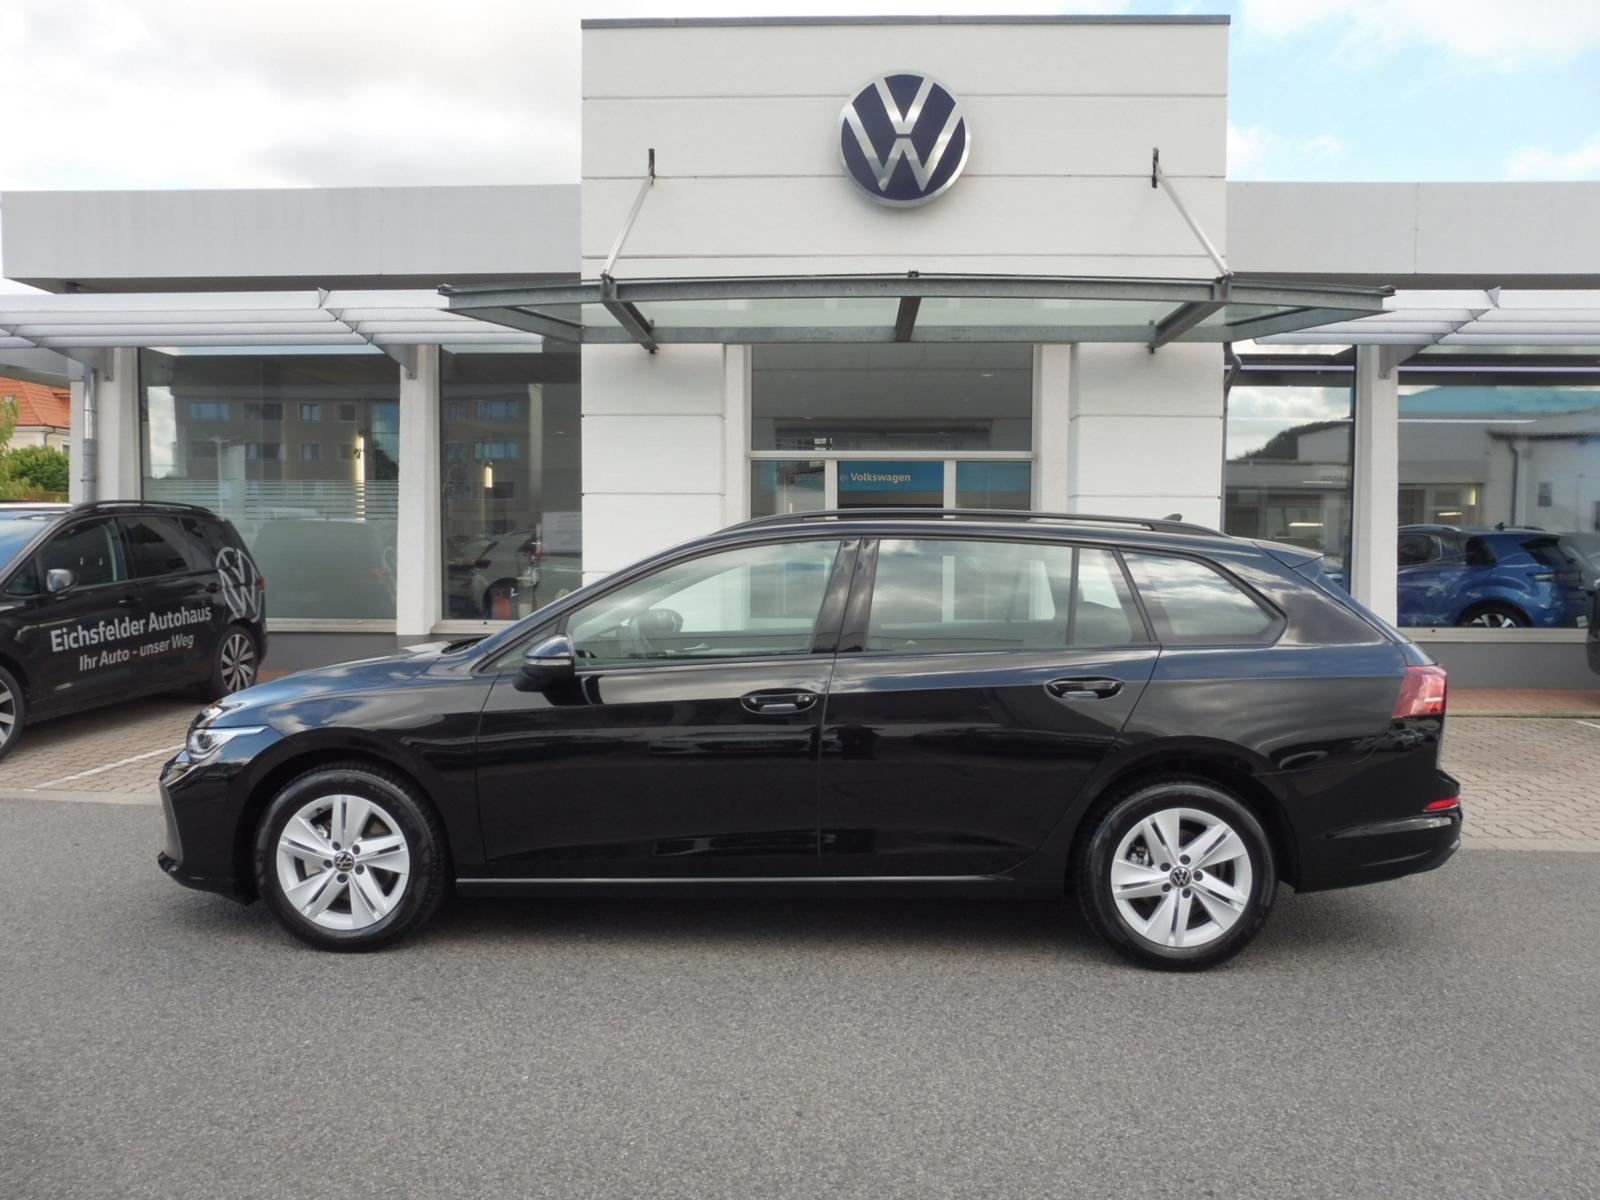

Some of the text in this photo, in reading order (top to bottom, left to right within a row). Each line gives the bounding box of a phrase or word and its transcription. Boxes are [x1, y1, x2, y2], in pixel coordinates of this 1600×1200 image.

[839, 72, 969, 202] VW
[850, 472, 912, 484] Volkswagen
[50, 606, 212, 652] Eichsfelder Autohaus
[79, 653, 98, 671] Ihr
[99, 649, 130, 667] Auto
[140, 639, 170, 656] unser
[171, 633, 194, 649] Weg
